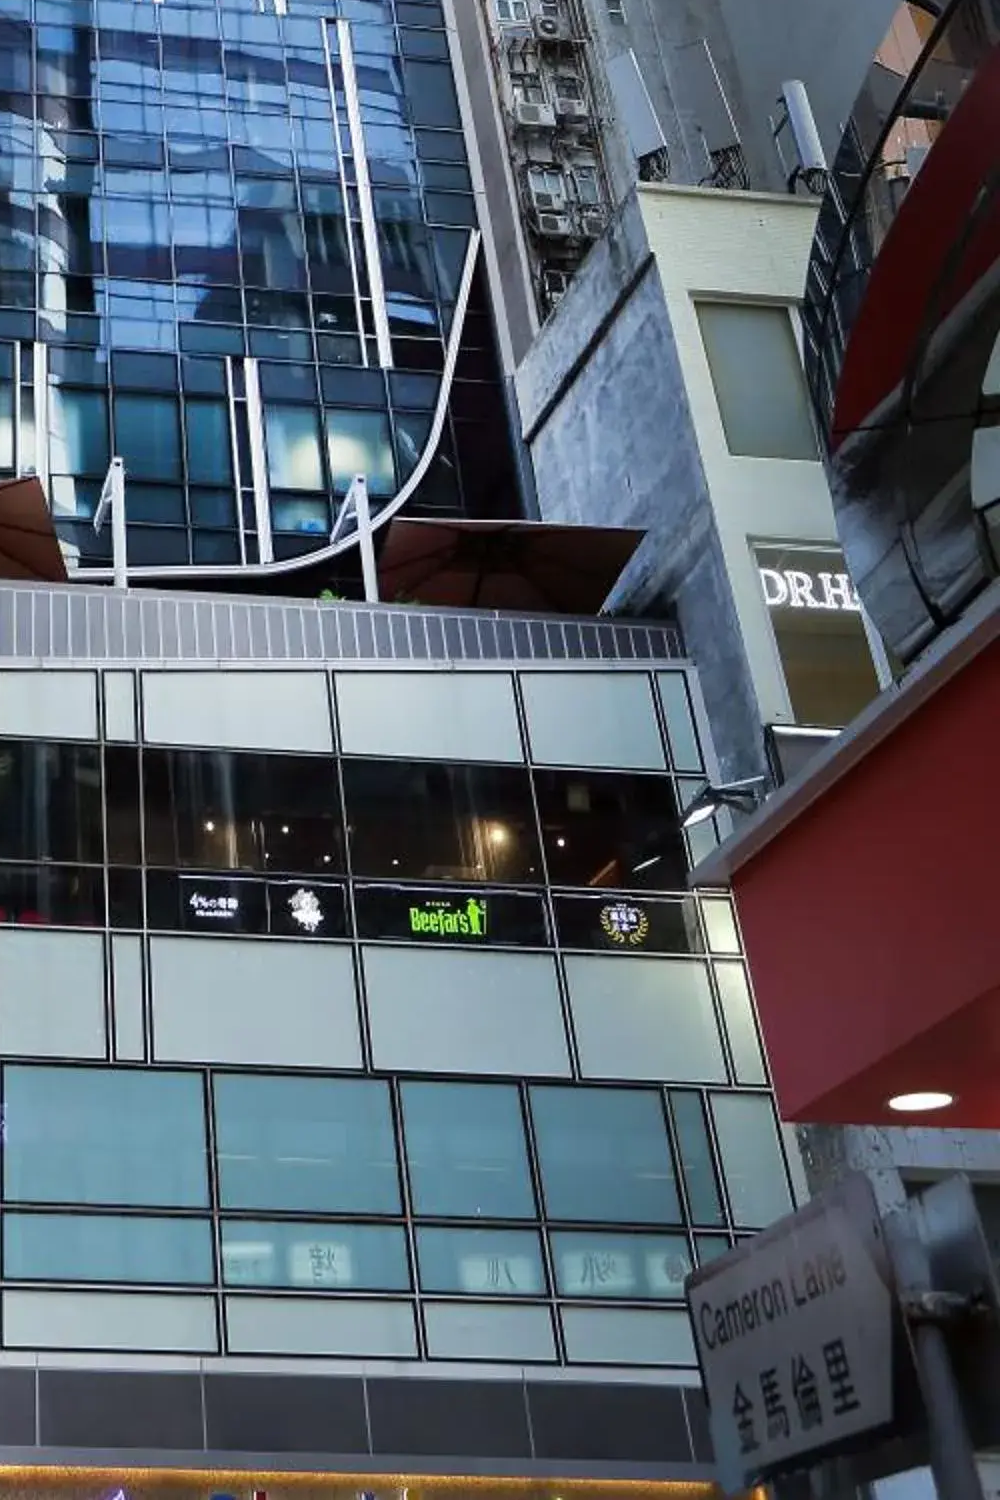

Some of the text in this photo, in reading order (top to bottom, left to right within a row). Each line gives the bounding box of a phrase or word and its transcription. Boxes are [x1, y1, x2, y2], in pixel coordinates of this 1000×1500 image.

[757, 567, 861, 611] DR.H
[409, 907, 469, 936] Beefar's
[699, 1251, 847, 1350] Cameron Lane
